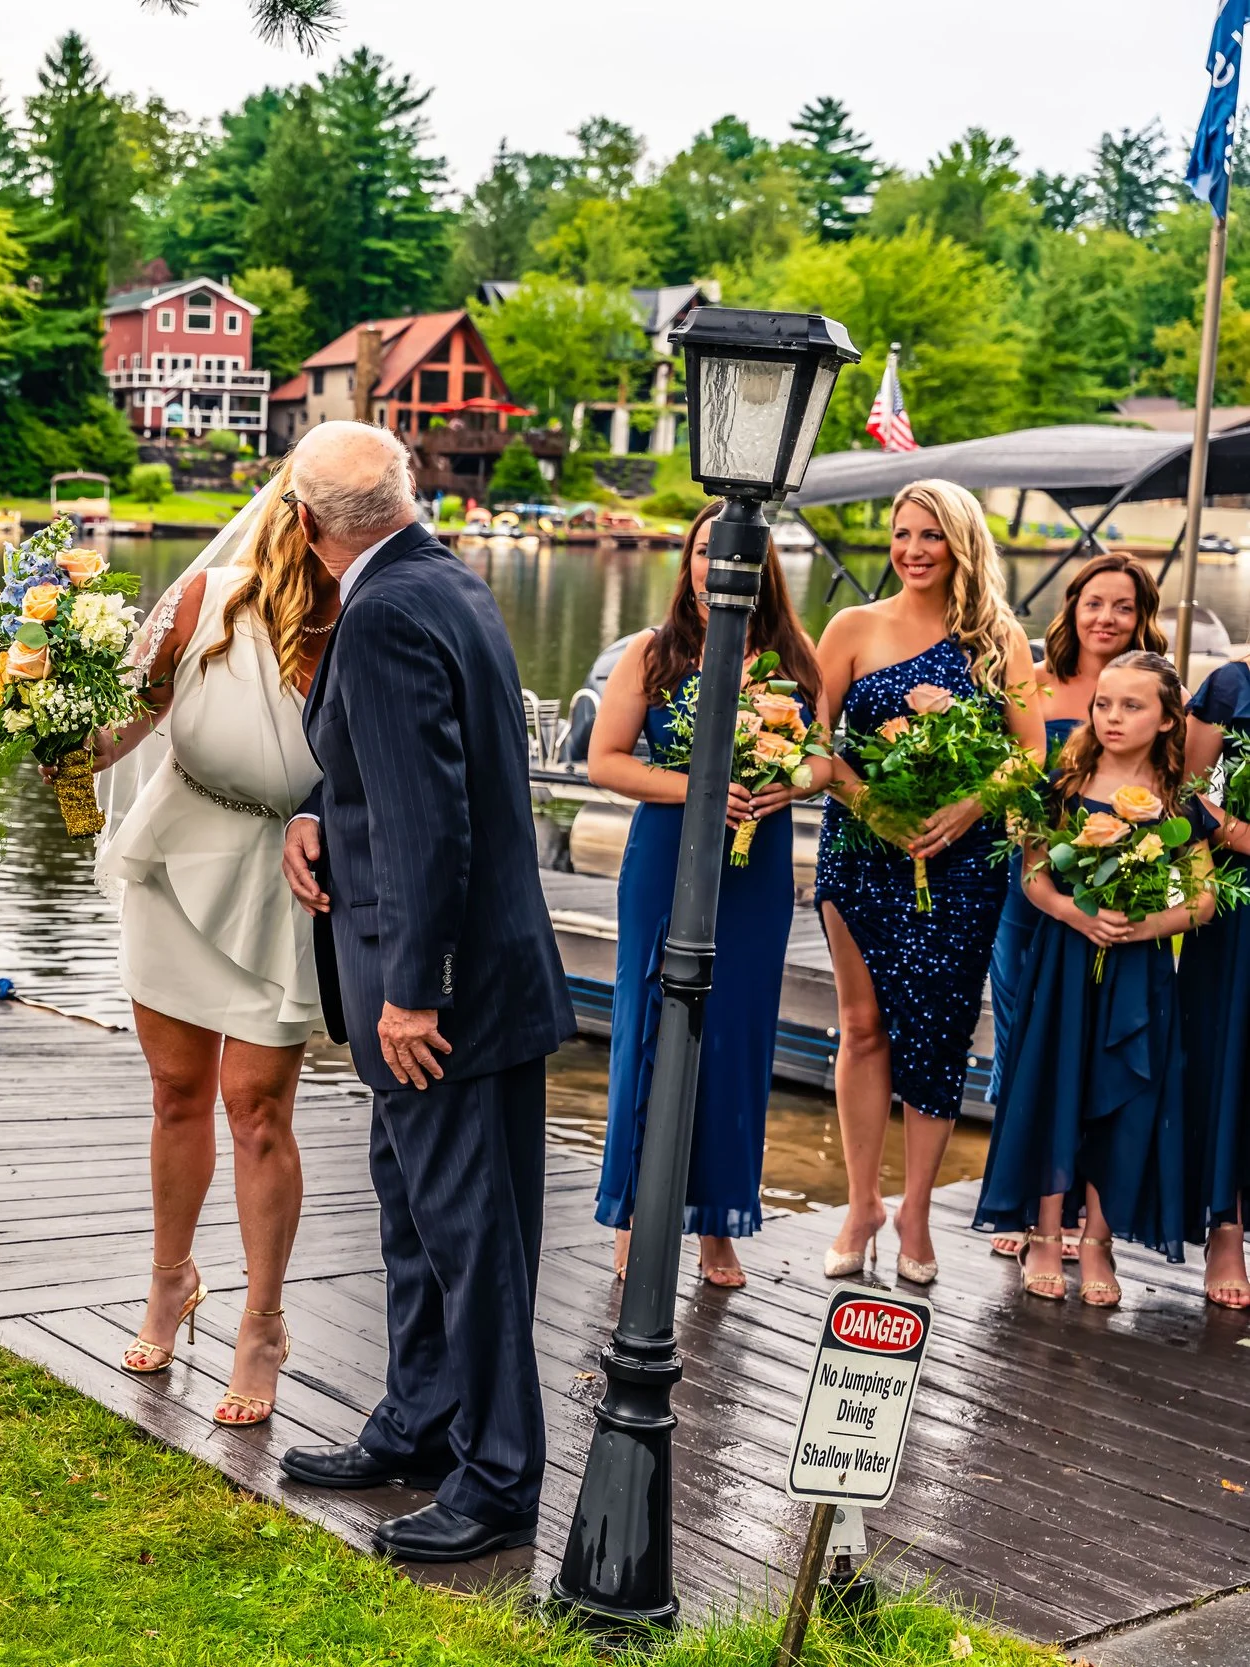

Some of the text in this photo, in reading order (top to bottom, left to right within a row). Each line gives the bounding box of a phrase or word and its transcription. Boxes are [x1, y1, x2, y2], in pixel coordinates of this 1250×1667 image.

[840, 1307, 915, 1347] DANGER
[819, 1363, 908, 1400] No Jumping or
[837, 1399, 877, 1430] Diving
[801, 1442, 891, 1473] Shallow Water
